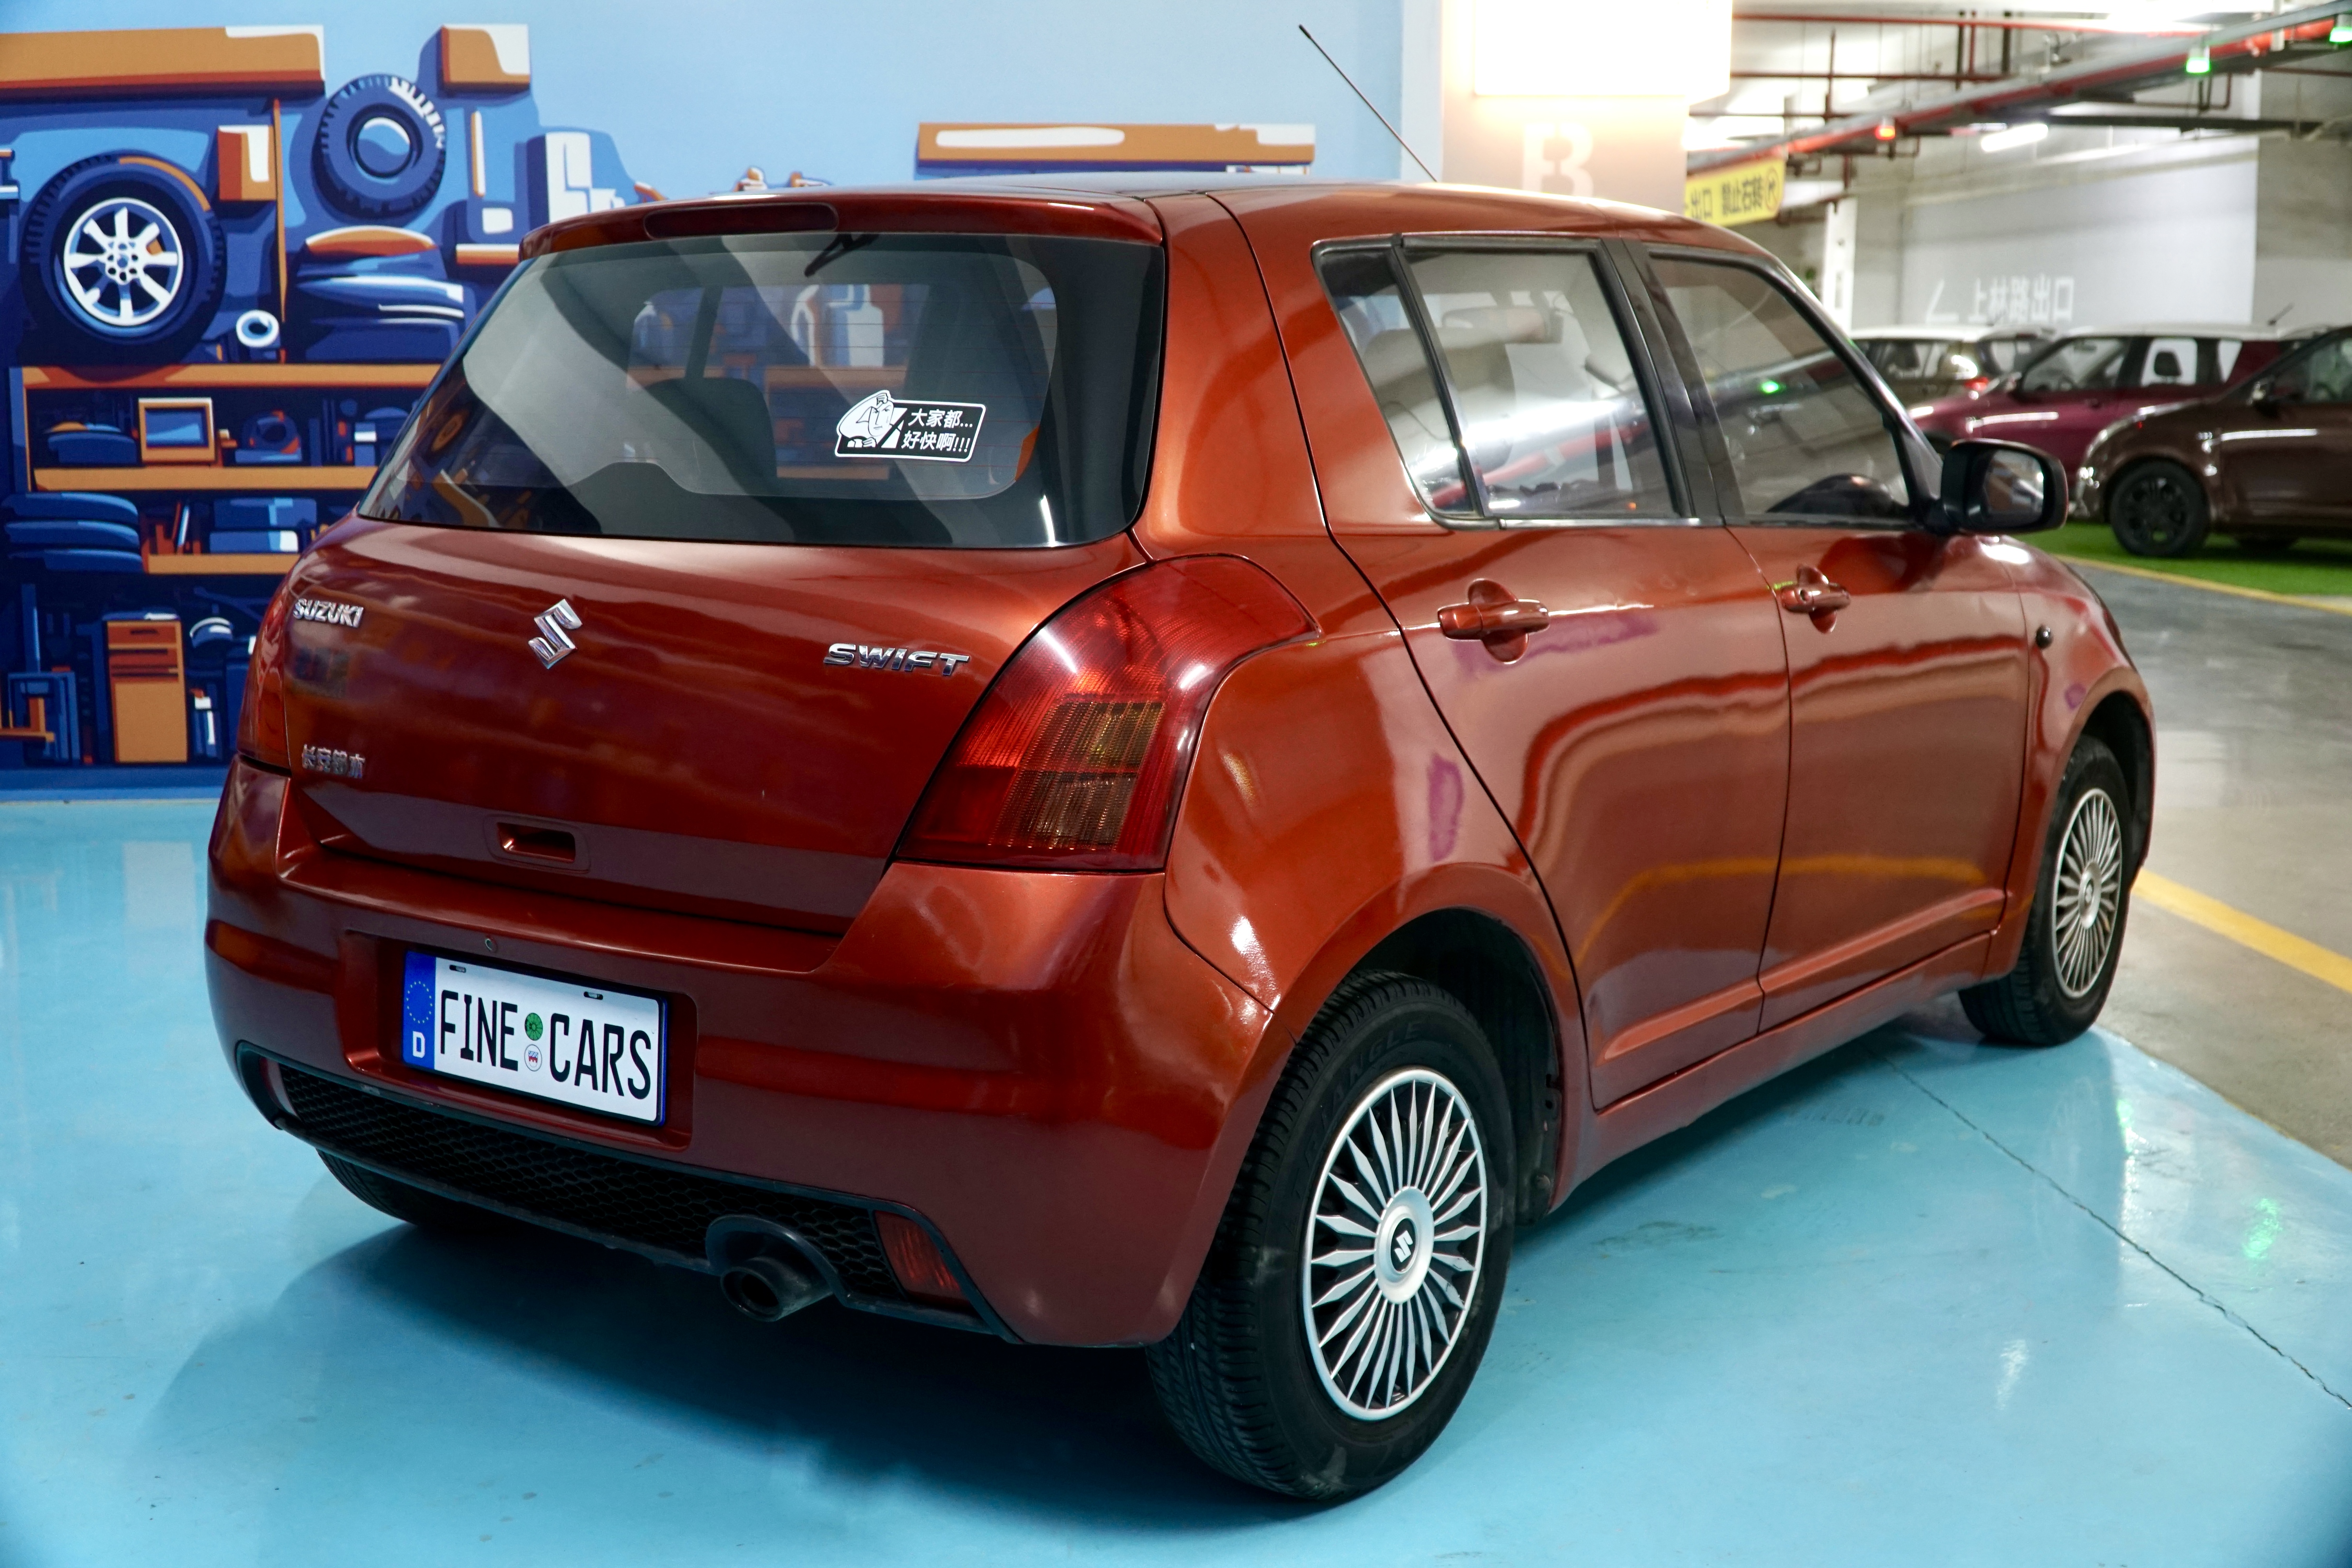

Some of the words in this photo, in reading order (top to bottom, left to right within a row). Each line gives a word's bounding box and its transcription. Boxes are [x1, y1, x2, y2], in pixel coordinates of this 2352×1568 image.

[294, 598, 364, 628] SUZUKI
[824, 643, 970, 676] SWIFT
[302, 744, 365, 779] 长安铃木
[412, 1032, 425, 1058] D
[440, 990, 518, 1072] FINE
[549, 1013, 652, 1100] CARS
